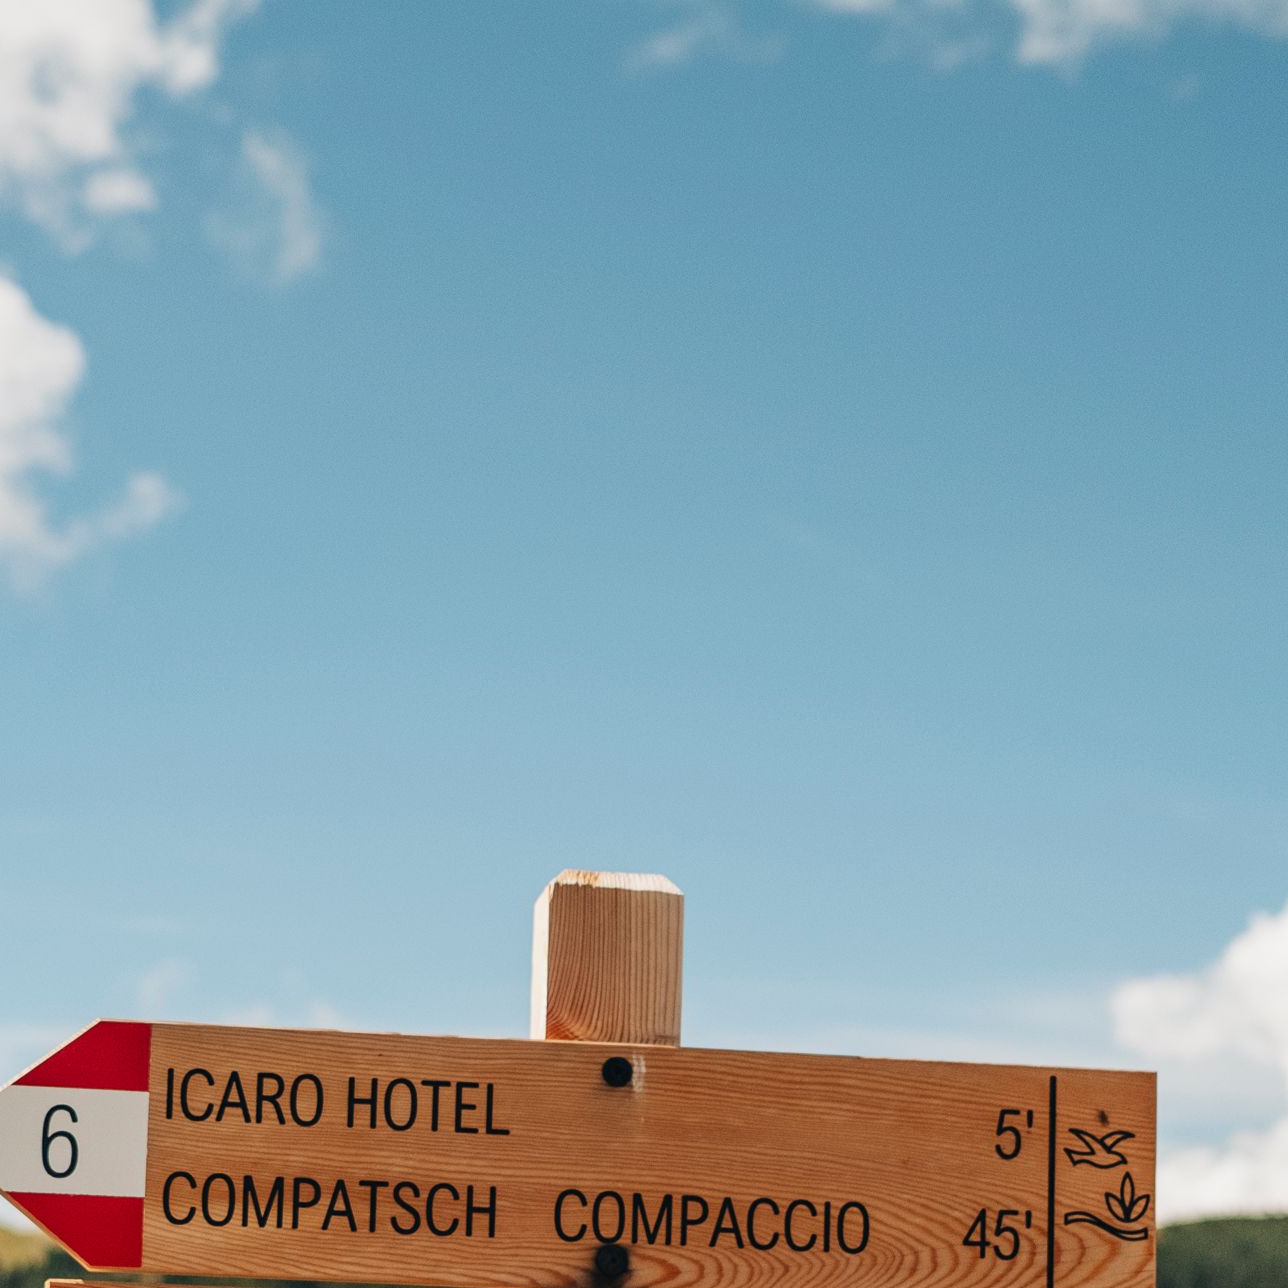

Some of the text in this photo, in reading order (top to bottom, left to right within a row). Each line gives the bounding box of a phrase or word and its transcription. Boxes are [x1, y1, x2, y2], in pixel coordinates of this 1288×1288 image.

[41, 1104, 78, 1178] 6
[166, 1068, 1033, 1160] ICARO HOTEL 5'
[162, 1171, 1031, 1260] COMPATSCH COMPACCIO 45'
